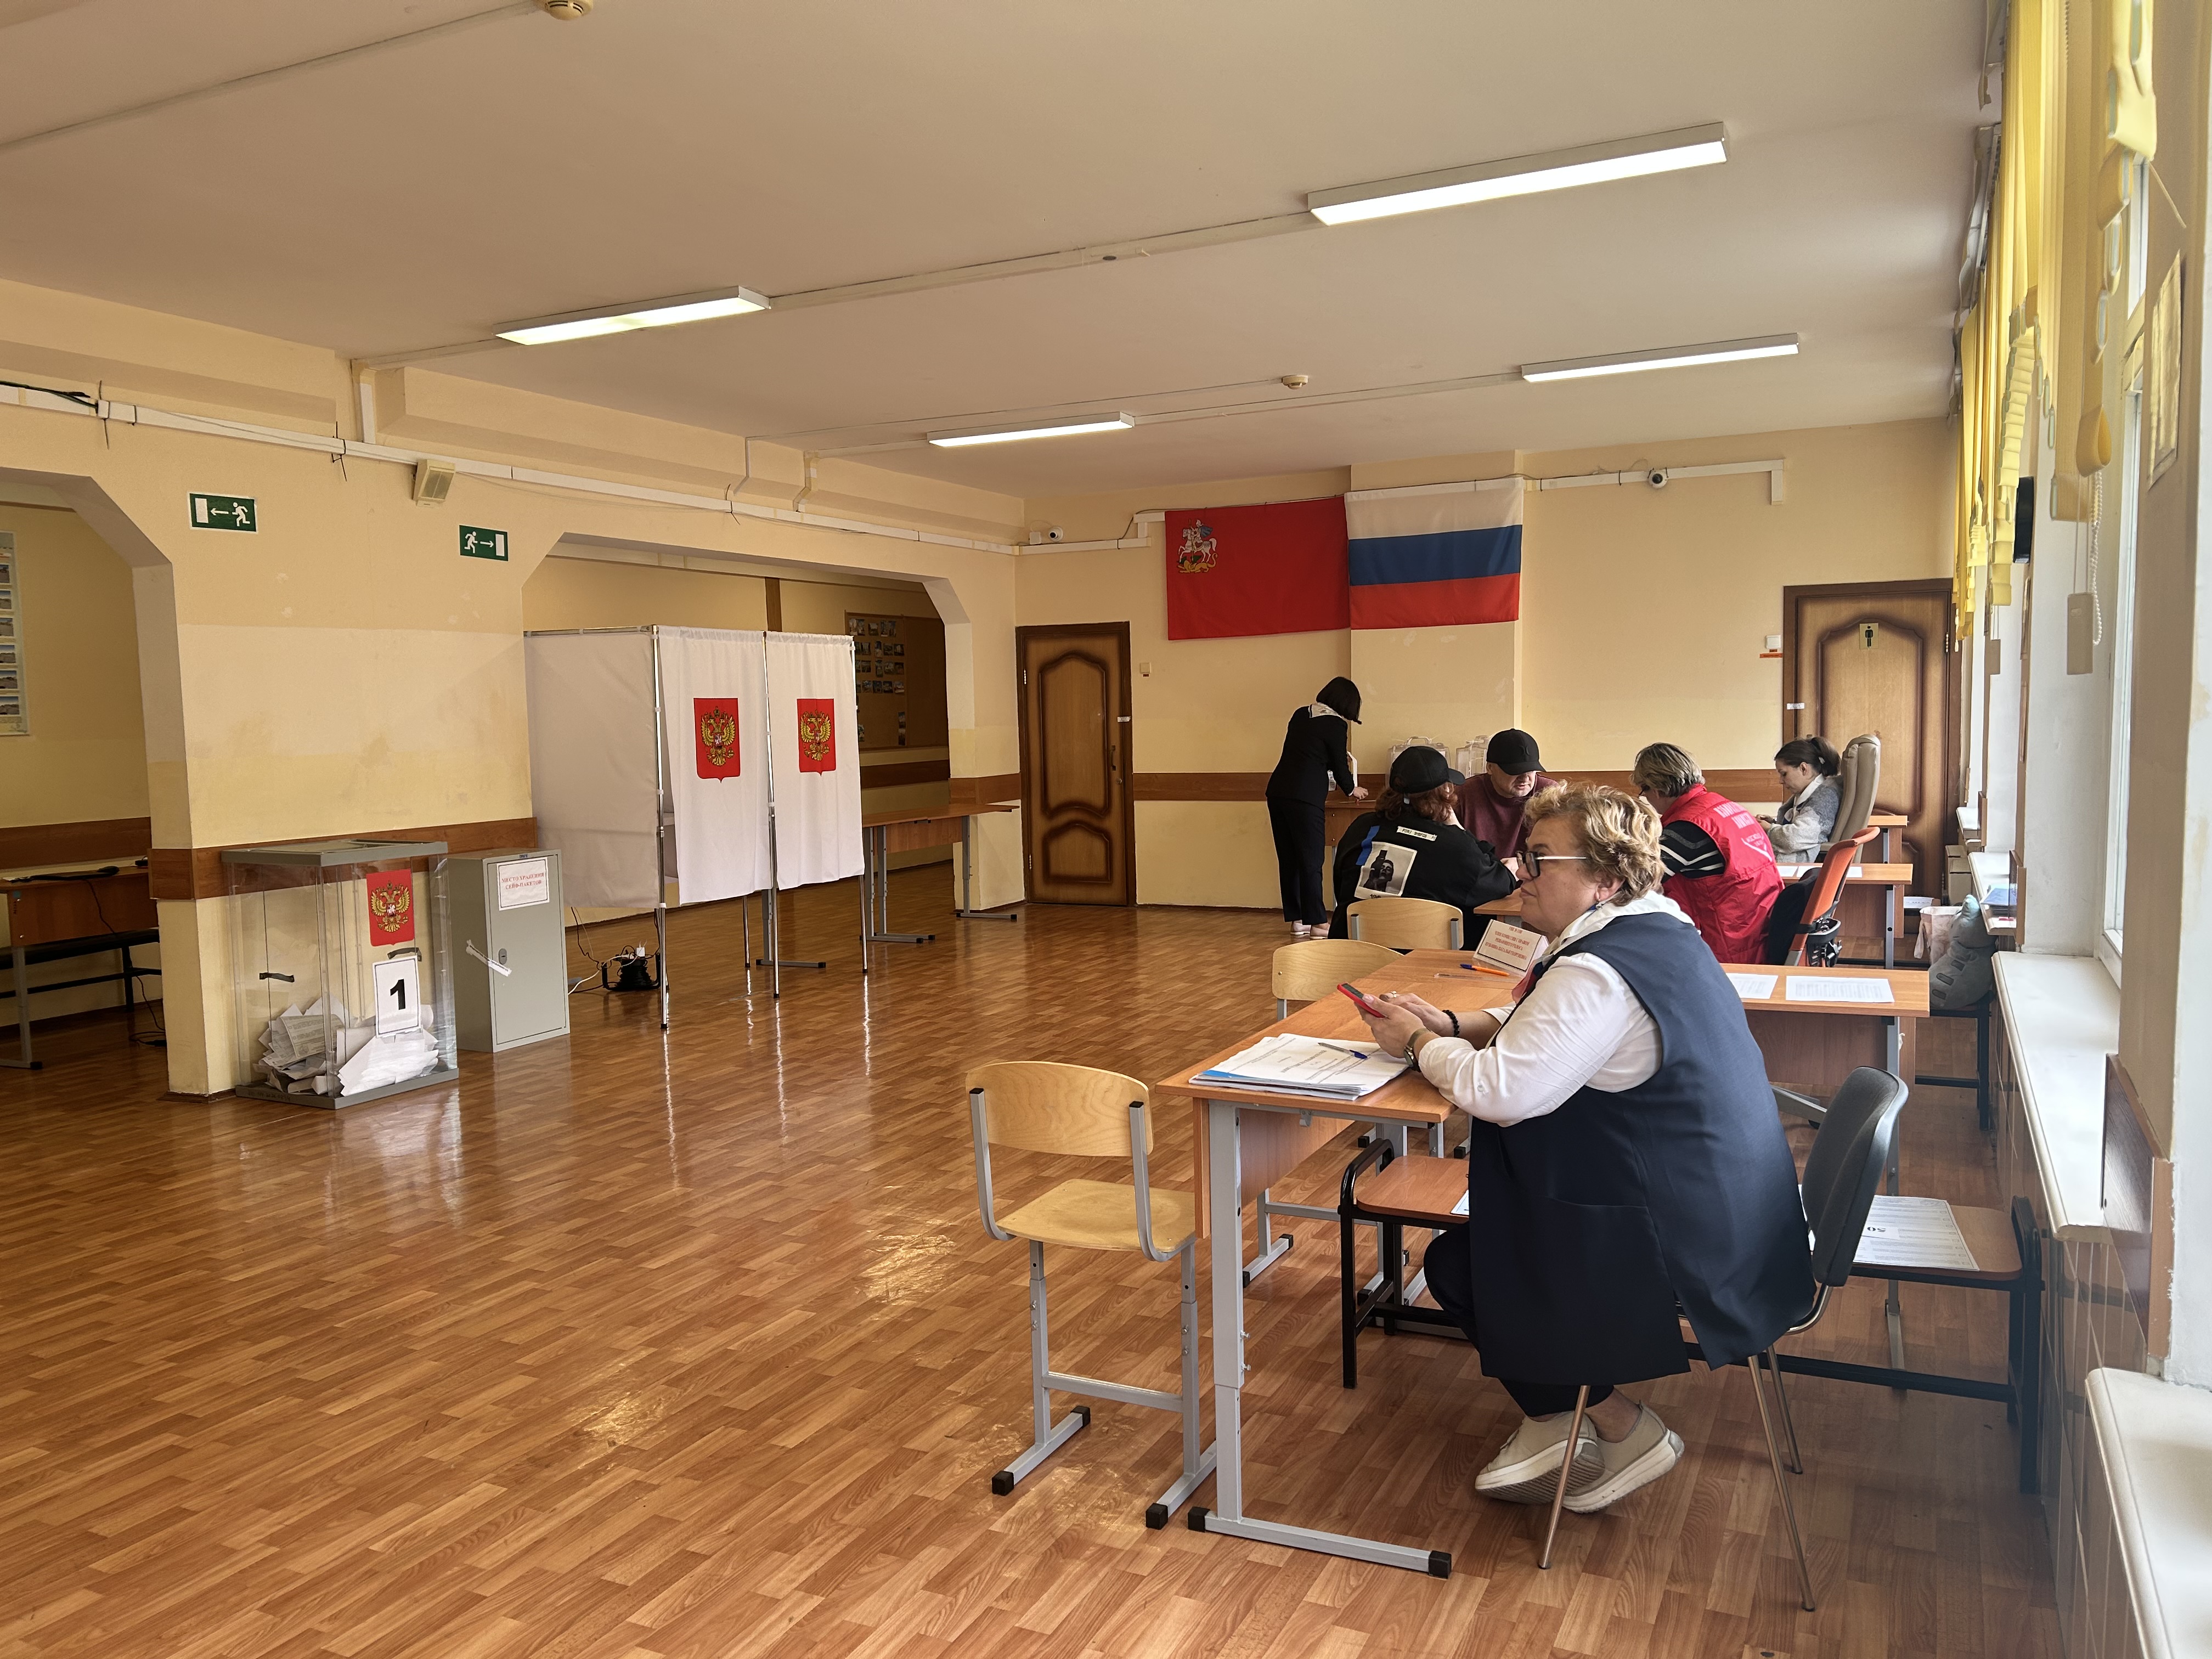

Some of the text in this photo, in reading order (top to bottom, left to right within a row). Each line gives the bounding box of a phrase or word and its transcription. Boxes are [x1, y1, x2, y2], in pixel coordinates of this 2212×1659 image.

[519, 872, 544, 881] ХРАНЕНИЯ
[505, 879, 542, 889] СЕЙФ-ПАКЕТОВ
[390, 979, 406, 1010] 1
